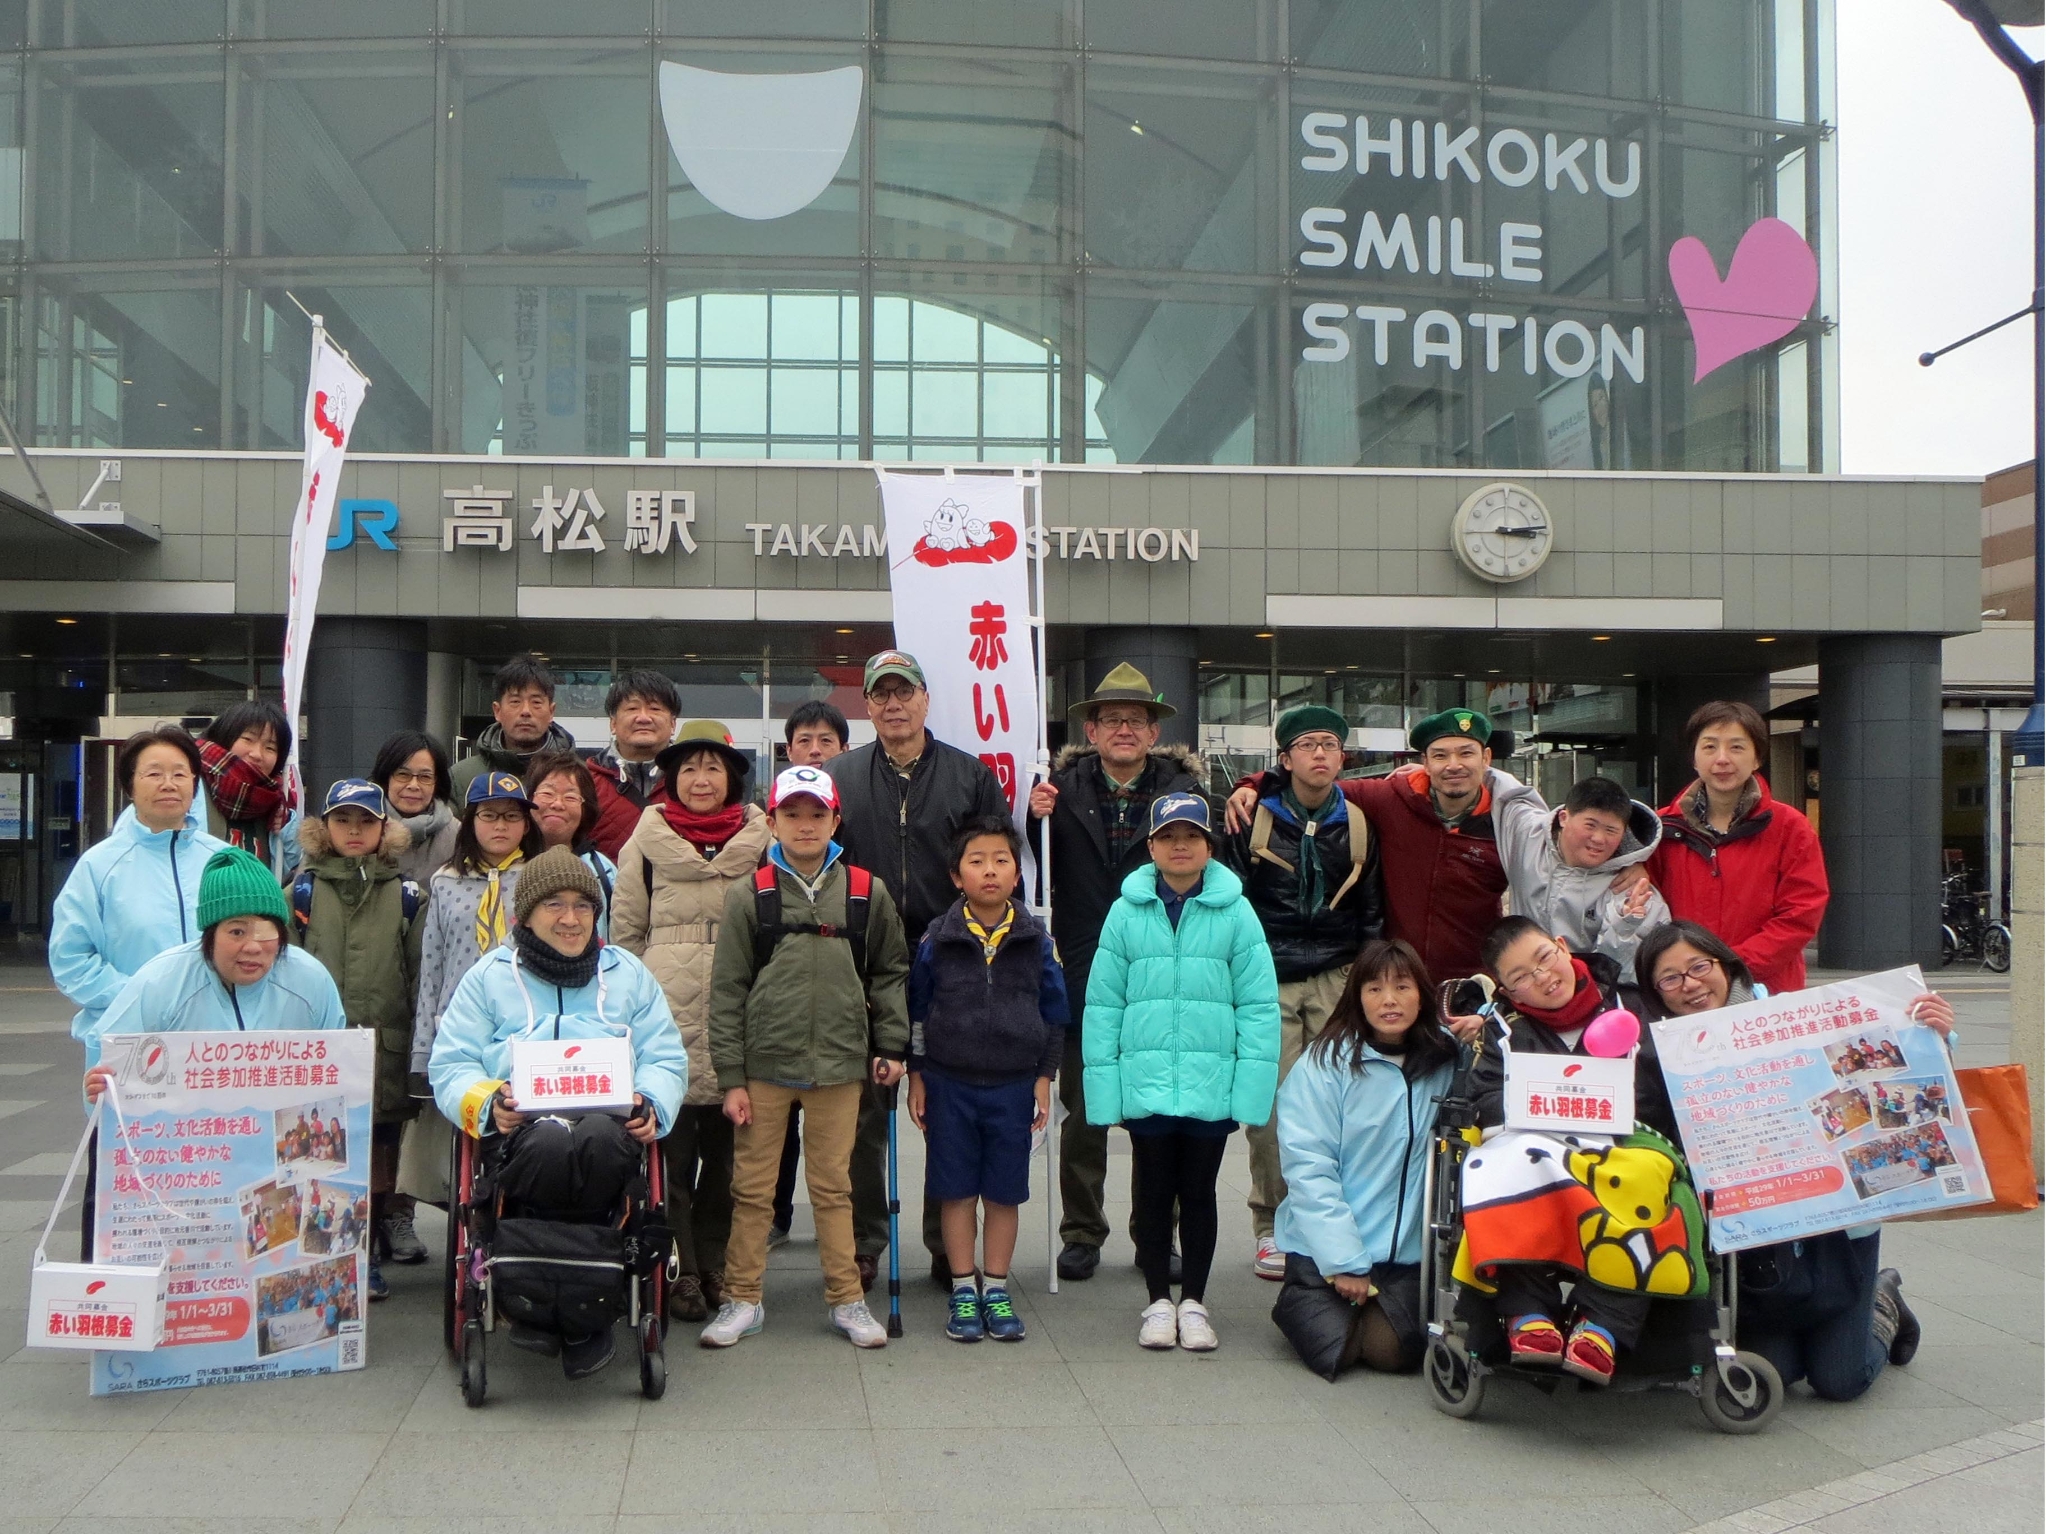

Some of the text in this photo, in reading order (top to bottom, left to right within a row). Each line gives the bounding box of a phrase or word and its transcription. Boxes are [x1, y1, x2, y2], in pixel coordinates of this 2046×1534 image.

[1300, 112, 1640, 197] SHIKOKU
[1300, 206, 1543, 283] SMILE
[1301, 302, 1645, 384] STATION
[325, 498, 399, 551] JR
[442, 484, 698, 554] 高松駅
[1025, 526, 1199, 562] STATION
[1730, 995, 1861, 1036] 人とのつながりによる
[1732, 1007, 1880, 1051] 社会参加推進活動募金
[184, 1040, 327, 1064] 人とのつながりによる
[184, 1064, 339, 1090] 社会参加推進活動募金
[557, 1065, 587, 1073] 共同募金
[1682, 1053, 1815, 1092] スポーツ、文化活動を通し
[533, 1074, 611, 1096] 赤い羽根募金
[1555, 1085, 1586, 1094] 共同募金
[1685, 1075, 1793, 1106] 孤立のない健やかな
[1529, 1094, 1612, 1120] 赤い羽根募金
[1690, 1093, 1789, 1123] 地域づくりのために
[113, 1171, 222, 1193] 地域づくりのために
[1708, 1152, 1834, 1185] 私たちの活動を支援してください。
[1744, 1182, 1775, 1196] 平成29年
[1748, 1195, 1776, 1207] 50万円
[48, 1312, 134, 1338] 赤い羽根募金
[108, 1382, 133, 1392] SARA
